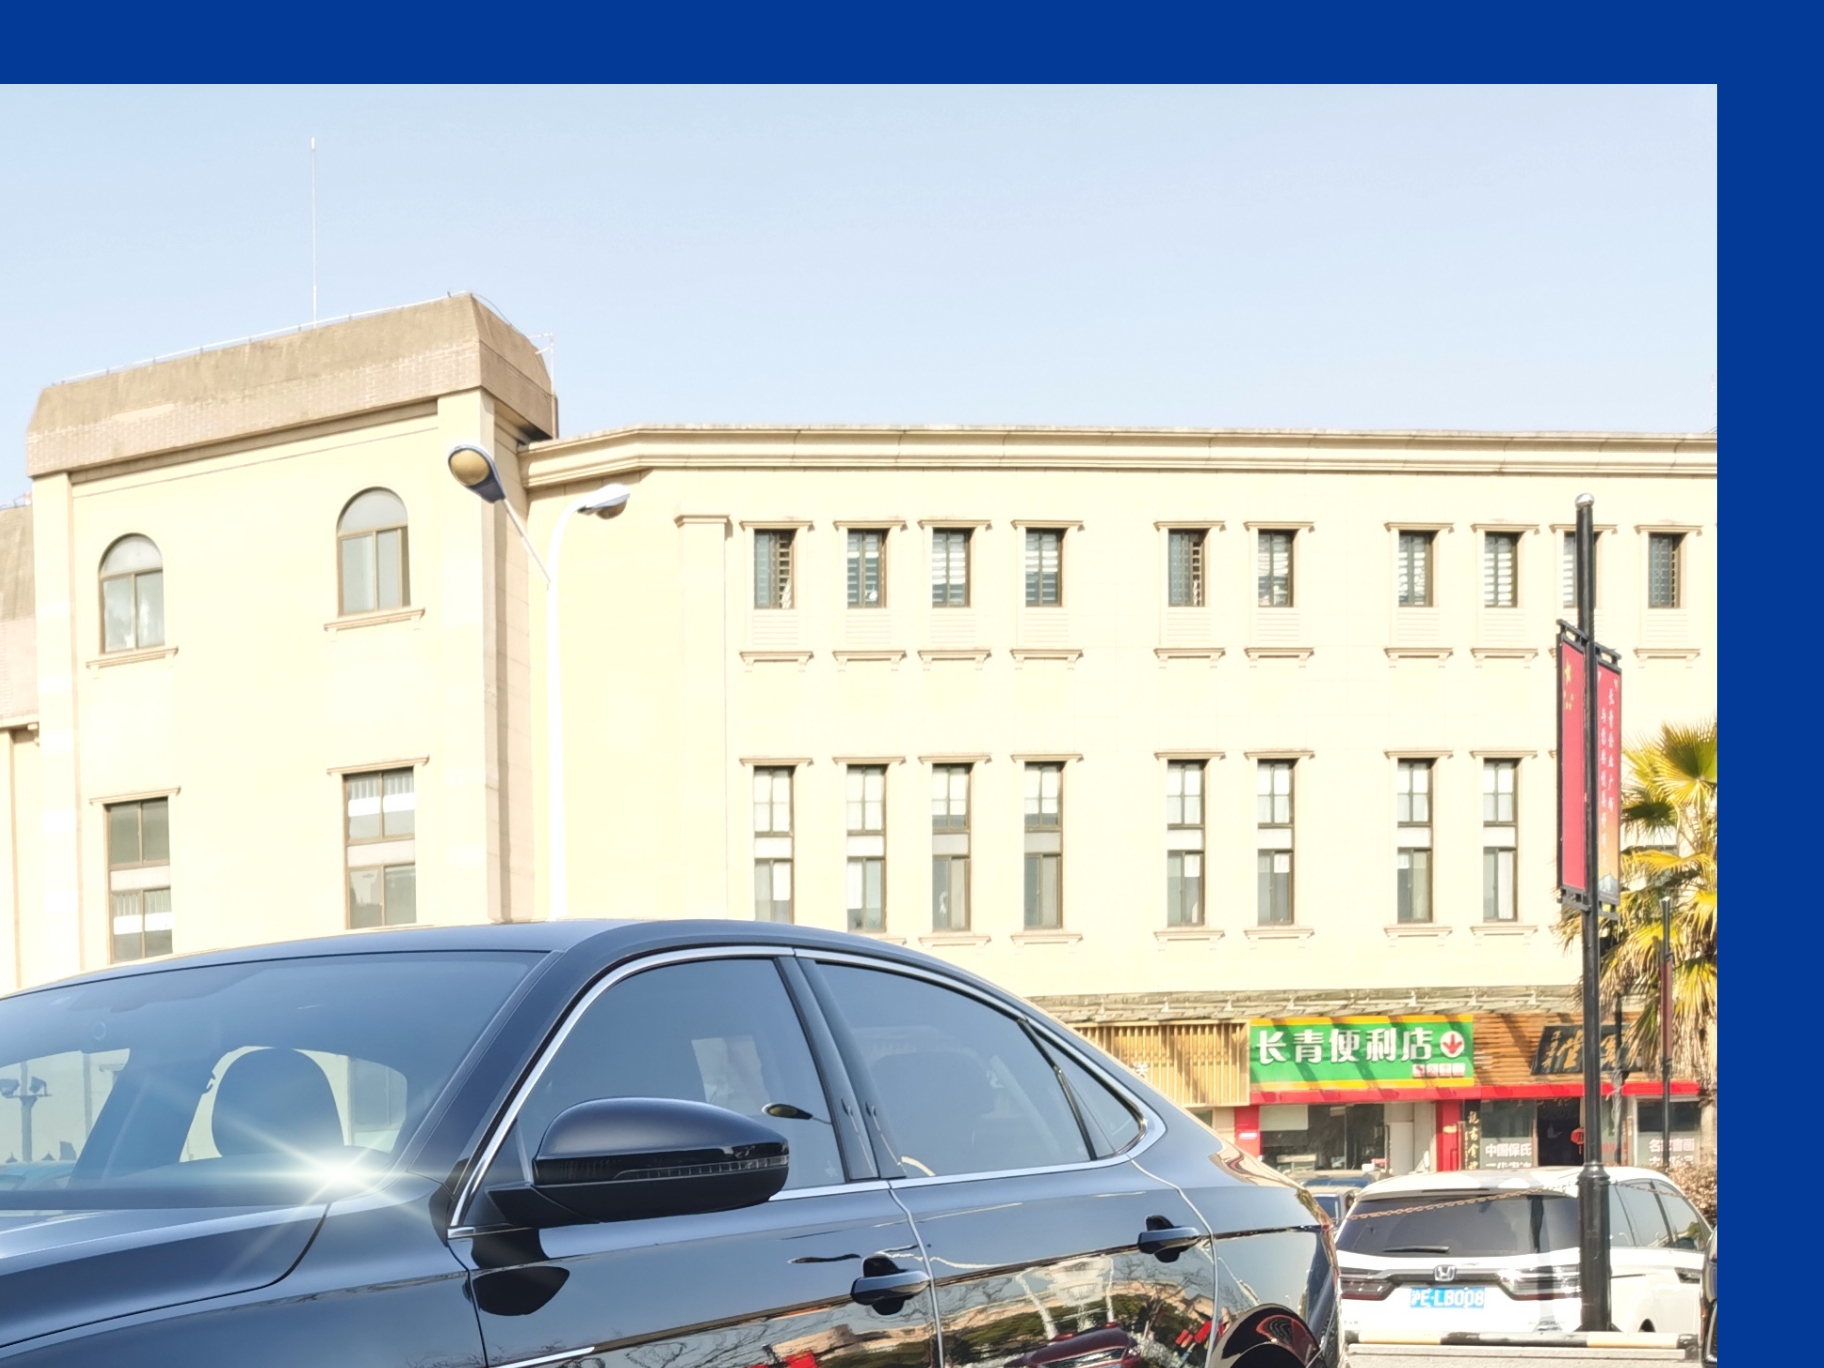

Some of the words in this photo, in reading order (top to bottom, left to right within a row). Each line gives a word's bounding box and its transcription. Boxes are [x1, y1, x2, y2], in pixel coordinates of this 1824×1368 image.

[1255, 1026, 1433, 1065] 长青便利店
